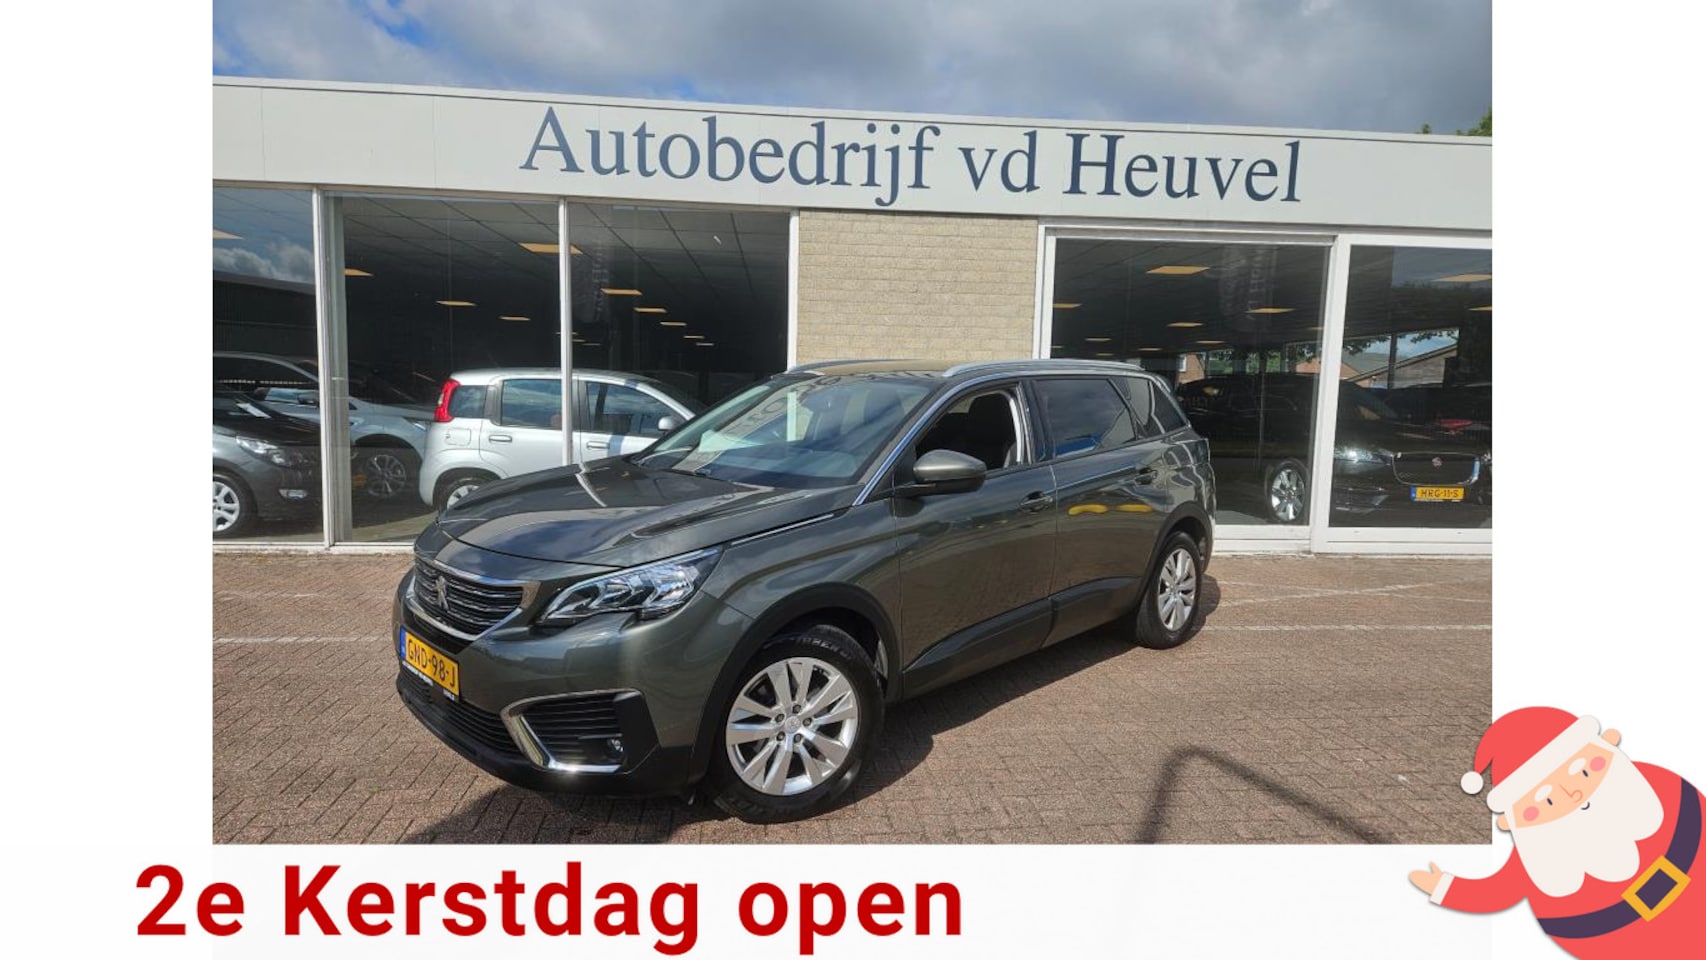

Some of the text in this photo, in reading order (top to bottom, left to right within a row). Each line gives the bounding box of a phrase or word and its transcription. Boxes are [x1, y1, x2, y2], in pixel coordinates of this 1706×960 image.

[520, 107, 1301, 206] Autobedrijf vd Heuvel
[407, 638, 456, 688] GND-98-J
